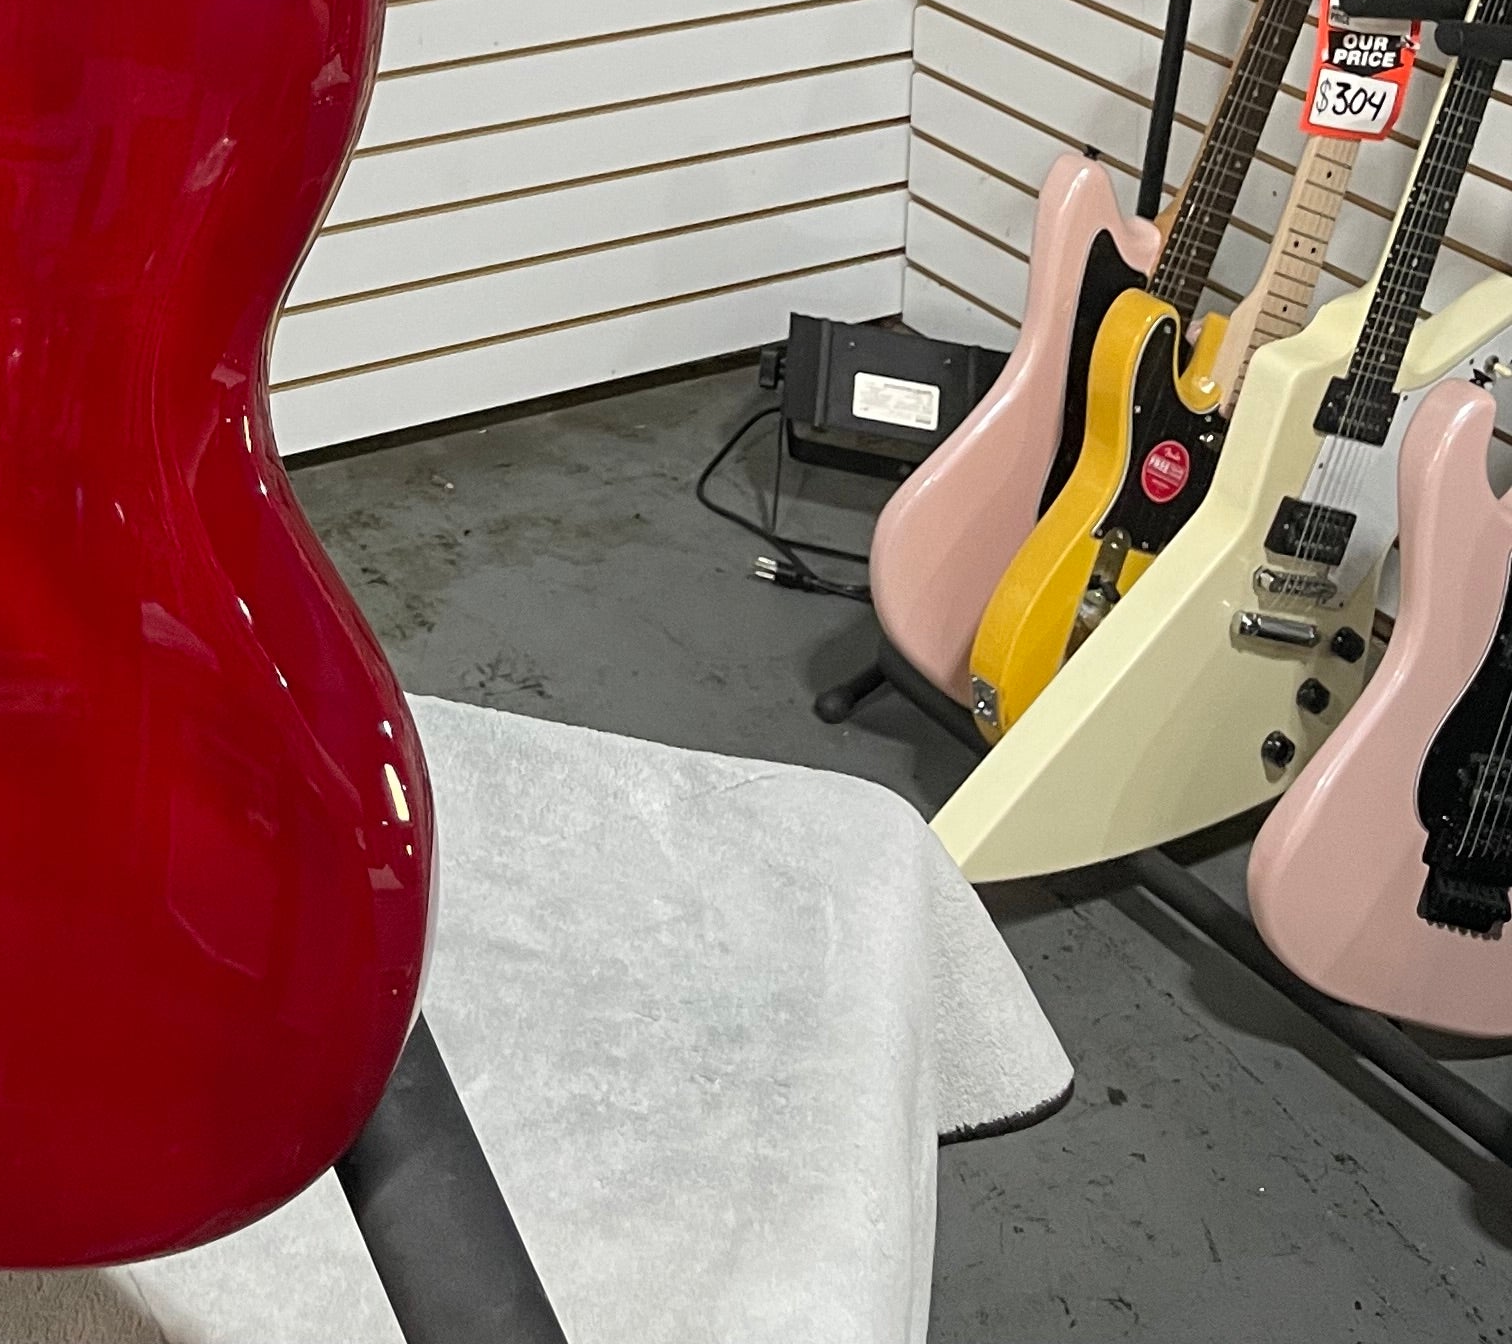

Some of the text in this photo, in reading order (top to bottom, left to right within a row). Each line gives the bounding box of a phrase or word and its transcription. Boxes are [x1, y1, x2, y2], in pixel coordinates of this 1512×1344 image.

[1342, 33, 1389, 52] OUR
[1332, 48, 1397, 68] PRICE
[1316, 78, 1387, 122] $304
